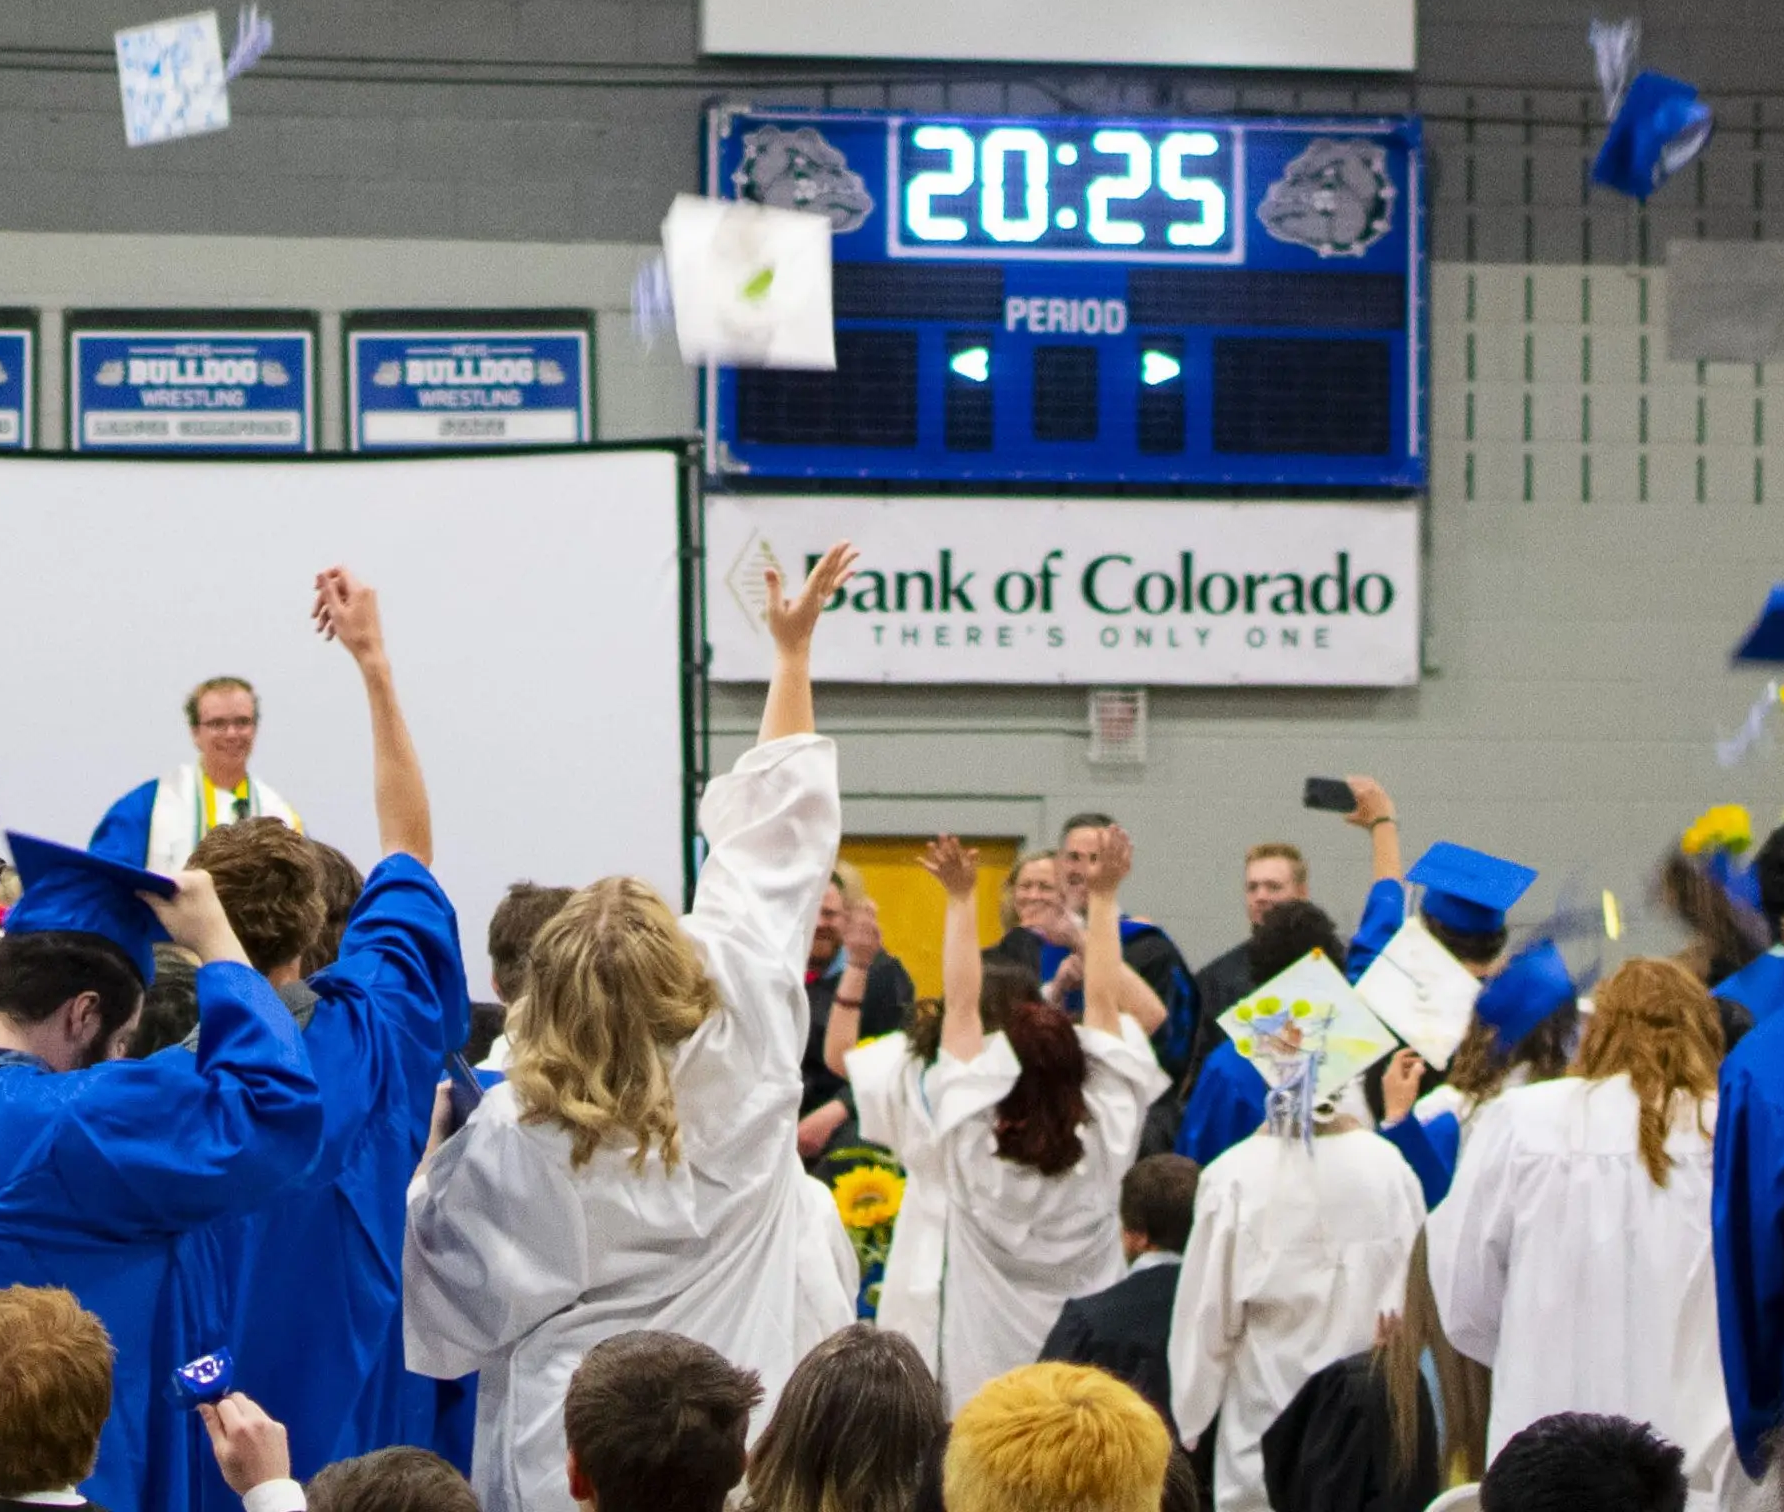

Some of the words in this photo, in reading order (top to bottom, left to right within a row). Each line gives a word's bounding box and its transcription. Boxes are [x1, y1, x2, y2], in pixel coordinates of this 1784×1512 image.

[907, 125, 1226, 246] 20:25
[1005, 297, 1126, 334] PERIOD
[128, 358, 258, 385] BULLDOG
[405, 358, 534, 385] BULLDOG
[140, 388, 245, 407] WRESTLING
[418, 388, 522, 407] WRESTLING
[993, 550, 1064, 615] of
[1080, 550, 1395, 615] Colorado
[871, 625, 1066, 649] THERE'S
[1100, 625, 1211, 649] ONLY
[1246, 625, 1331, 649] ONE
